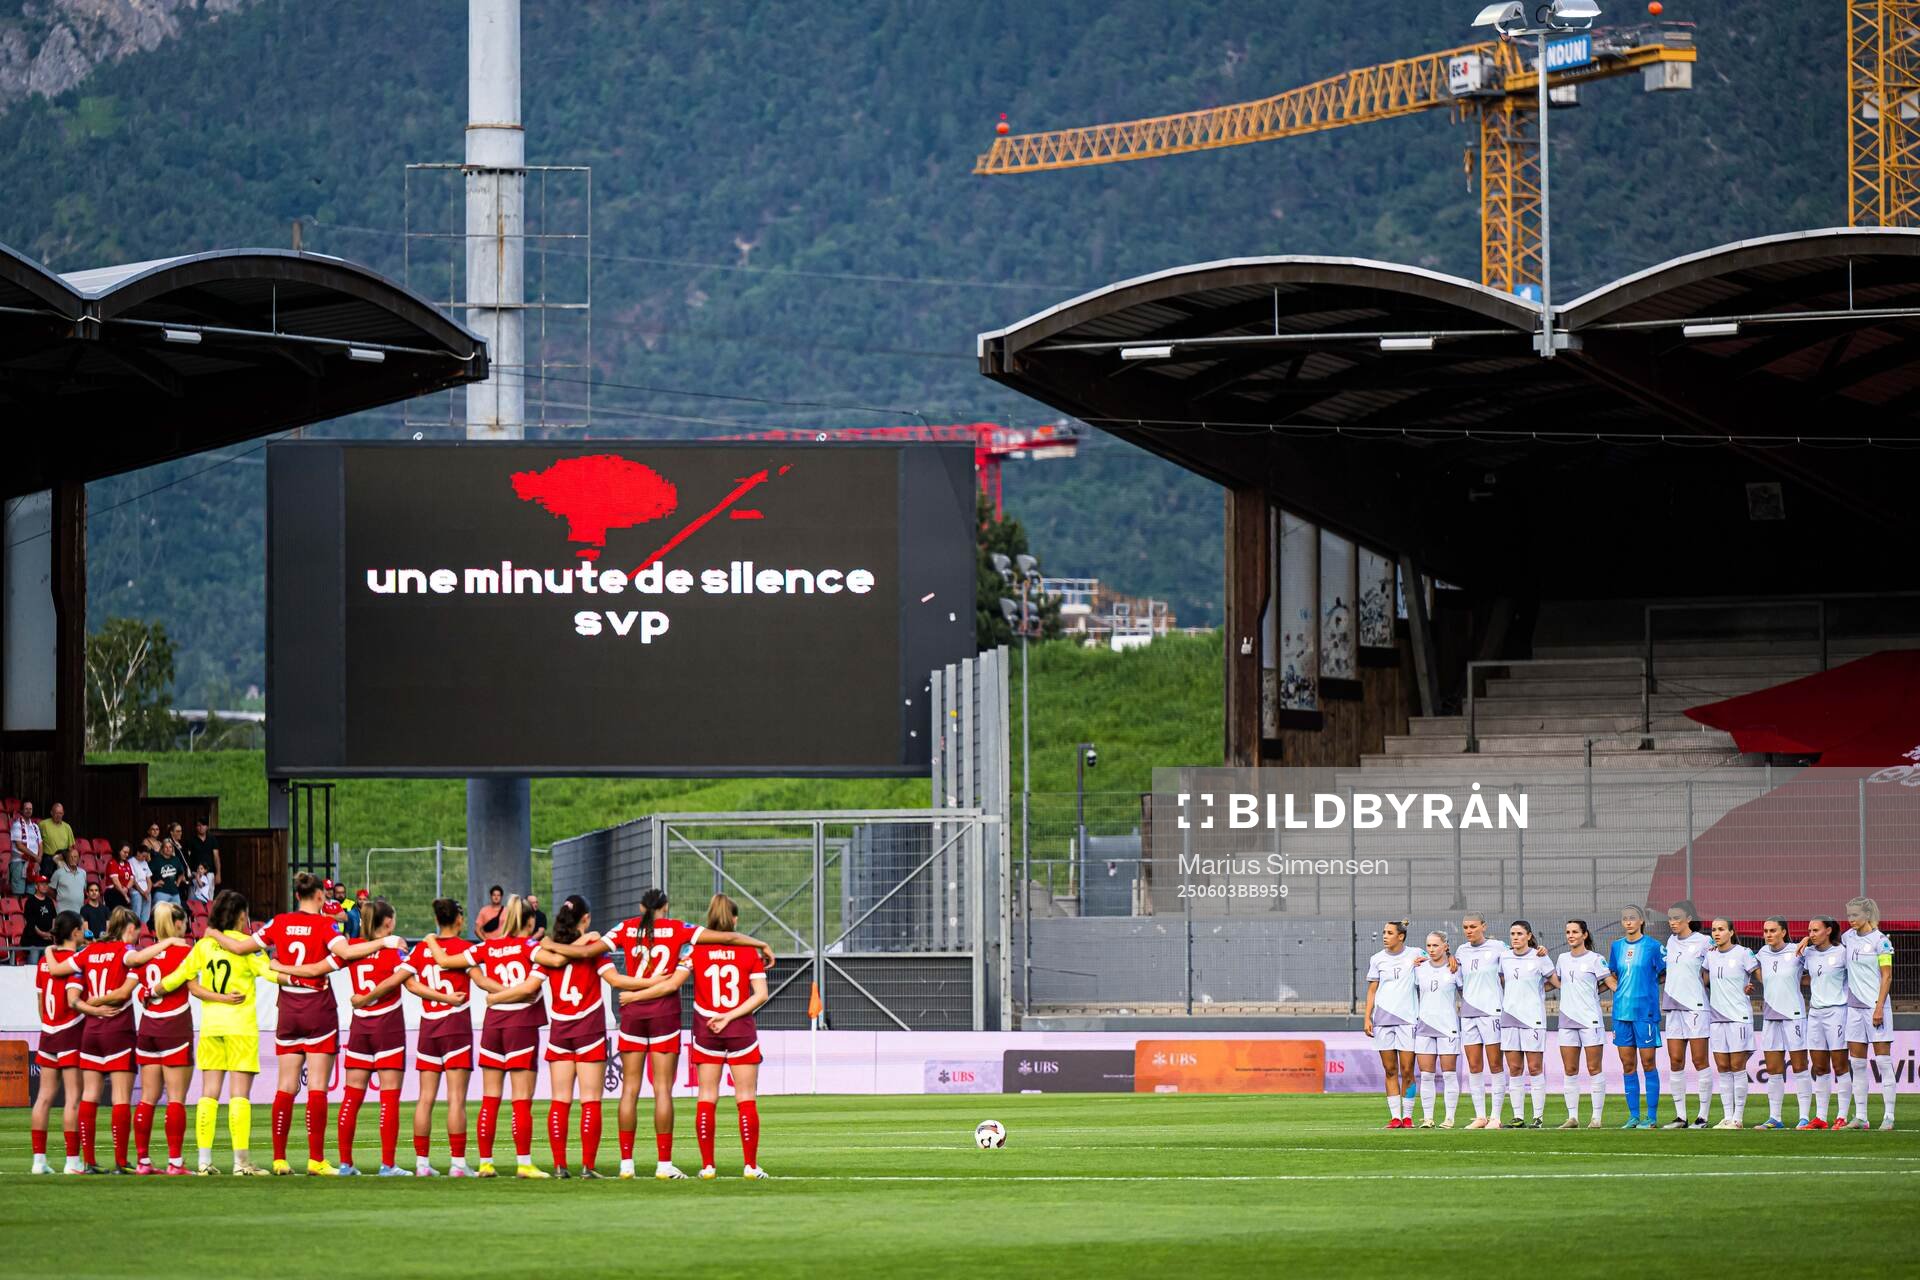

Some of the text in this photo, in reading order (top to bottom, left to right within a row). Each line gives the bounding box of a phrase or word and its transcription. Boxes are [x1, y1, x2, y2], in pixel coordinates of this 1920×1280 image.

[367, 561, 875, 594] une minute de silence
[575, 611, 670, 644] svp
[45, 978, 56, 1020] 6
[357, 964, 379, 1006] 5
[560, 964, 583, 1006] 4
[704, 964, 740, 1008] 13
[1034, 1061, 1060, 1074] UBS
[1169, 1052, 1197, 1066] UBS
[952, 1071, 975, 1083] UBS
